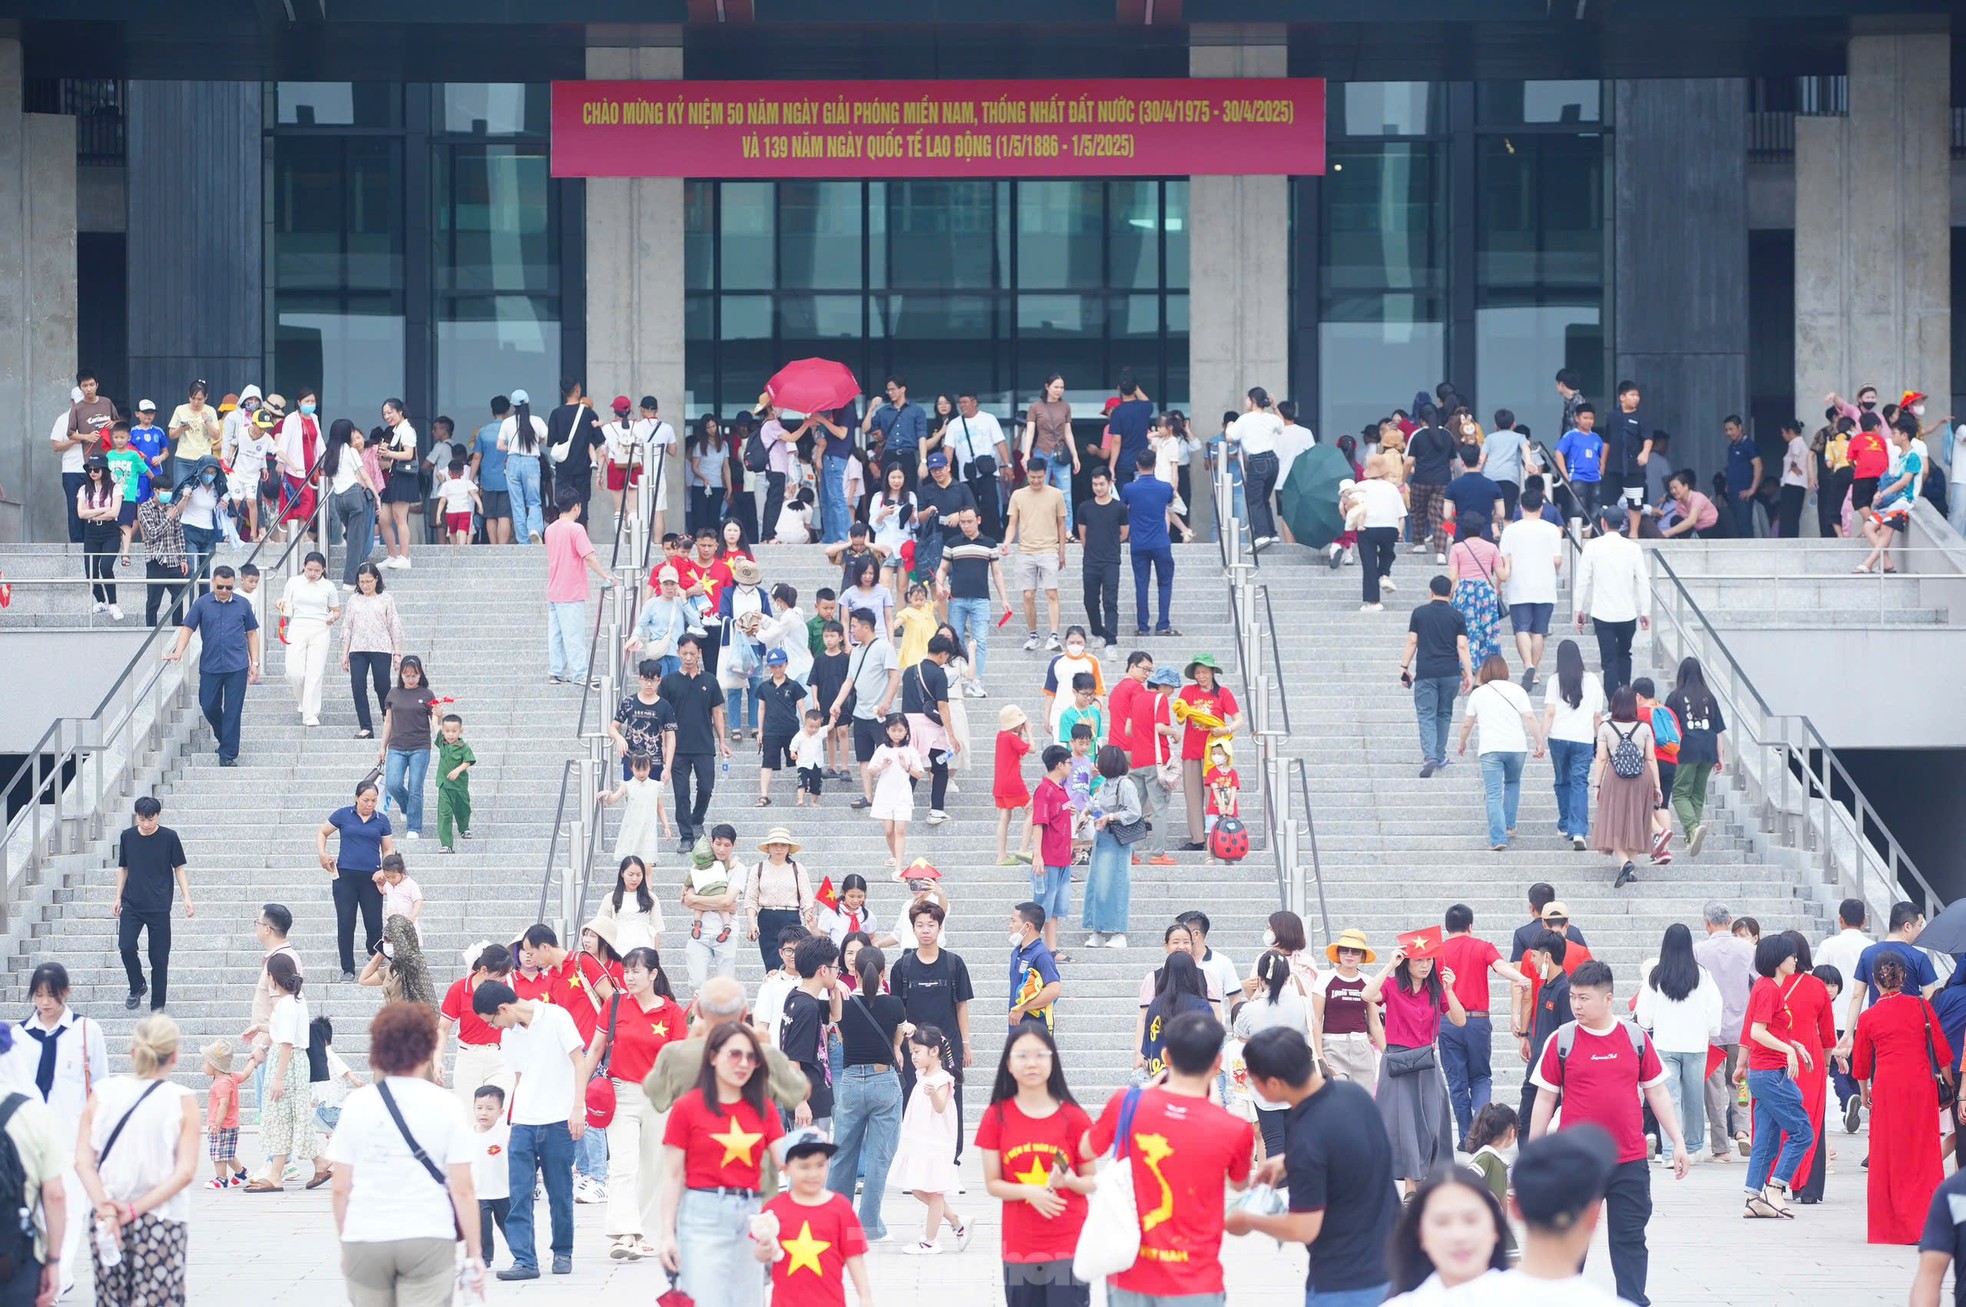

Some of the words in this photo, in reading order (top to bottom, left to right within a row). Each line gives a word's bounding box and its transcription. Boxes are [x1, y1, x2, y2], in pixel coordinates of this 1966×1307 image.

[582, 97, 620, 126] CHÀO
[622, 99, 664, 126] MỪNG
[666, 95, 686, 126] KỶ
[688, 98, 724, 129] NIỆM
[727, 102, 745, 126] 50
[747, 99, 781, 126] NĂM
[782, 98, 820, 126] NGÀY
[823, 95, 851, 126] GIẢI
[853, 98, 901, 126] PHÓNG
[903, 95, 940, 126] MIỀN
[941, 100, 978, 127] NAM,
[981, 94, 1027, 125] THỐNG
[1029, 93, 1066, 125] NHẤT
[1068, 94, 1096, 125] ĐẤT
[1097, 95, 1136, 124] NƯỚC
[1138, 99, 1211, 125] (30/4/1975
[1222, 99, 1295, 125] 30/4/2025)
[742, 131, 761, 159] VÀ
[764, 135, 789, 159] 139
[791, 132, 825, 159] NĂM
[826, 132, 864, 159] NGÀY
[866, 128, 904, 161] QUỐC
[906, 130, 923, 159] TẾ
[925, 135, 952, 159] LAO
[954, 131, 993, 162] ĐỘNG
[995, 134, 1060, 159] (1/5/1886
[1072, 134, 1136, 158] 1/5/2025)
